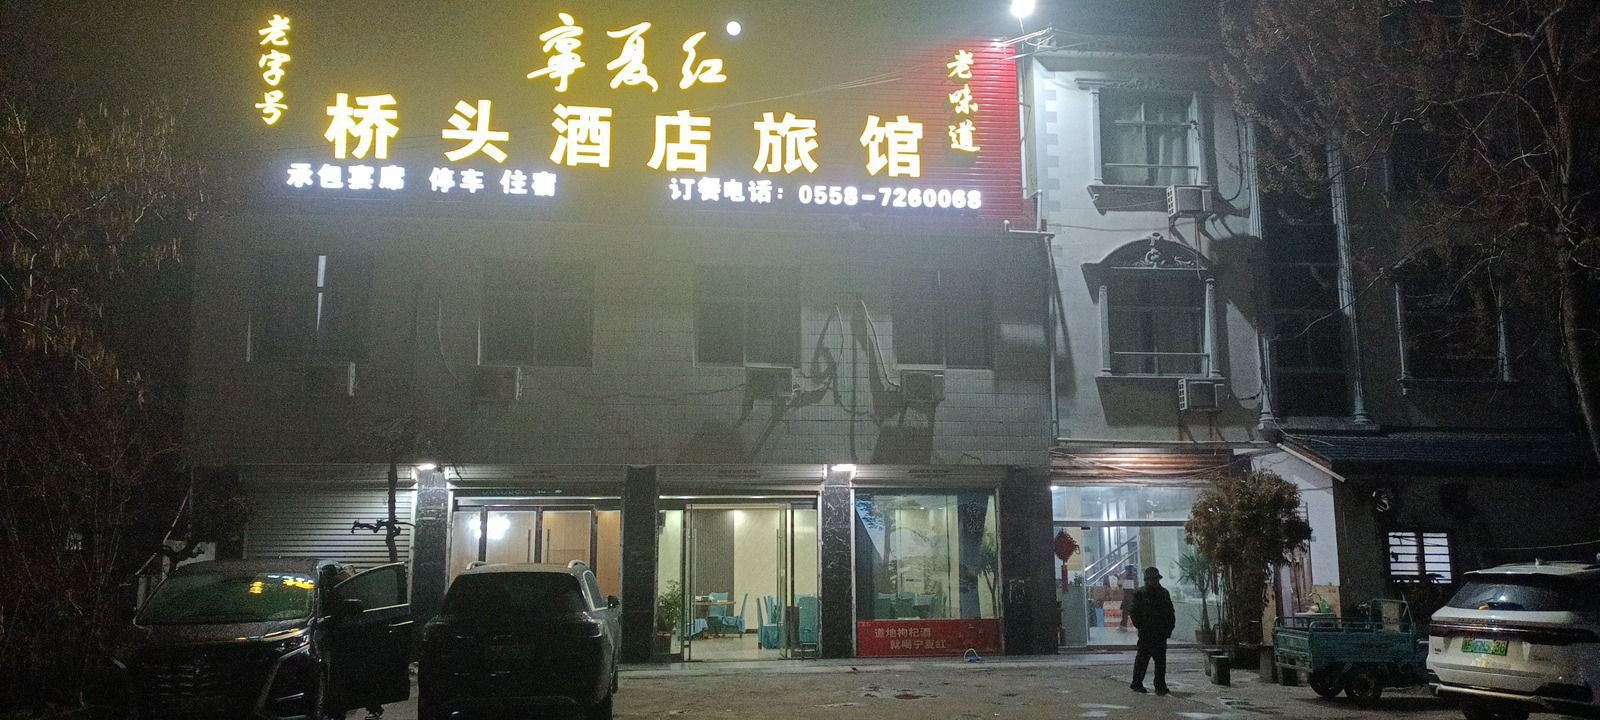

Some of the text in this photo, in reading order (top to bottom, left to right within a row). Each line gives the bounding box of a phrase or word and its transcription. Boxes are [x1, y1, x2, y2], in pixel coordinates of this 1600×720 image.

[255, 13, 291, 126] 老字号
[946, 48, 981, 153] 老味道
[323, 93, 923, 178] 桥头酒店旅馆
[429, 167, 484, 194] 停车
[499, 169, 557, 197] 住宿
